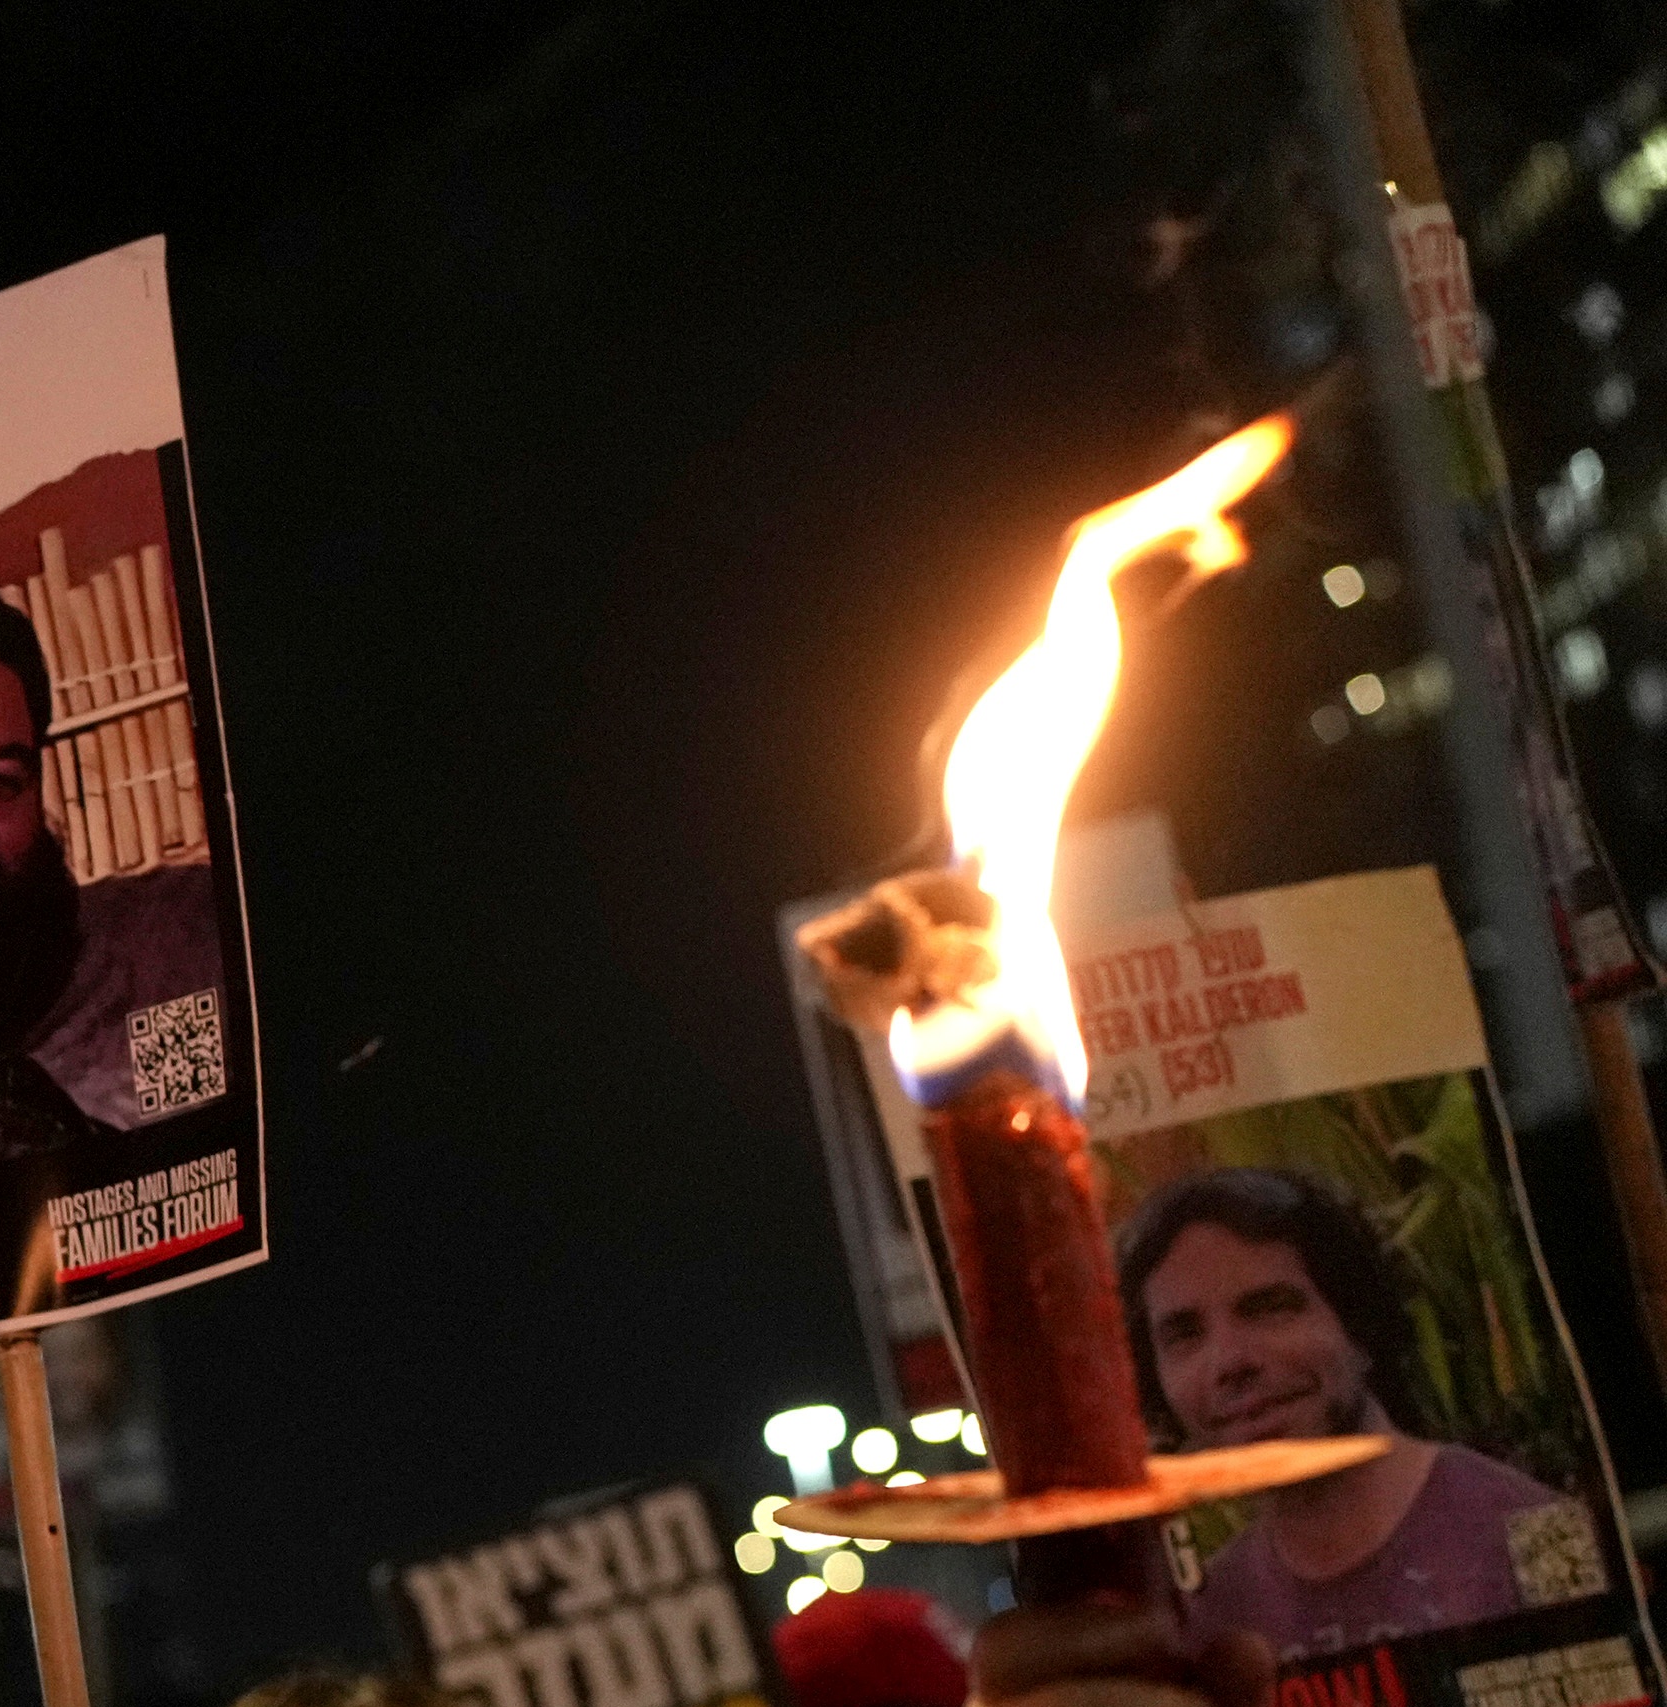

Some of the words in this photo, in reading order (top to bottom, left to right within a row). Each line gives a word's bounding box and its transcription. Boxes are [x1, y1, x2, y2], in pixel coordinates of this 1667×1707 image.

[1141, 969, 1308, 1045] KALDERON
[48, 1180, 135, 1228] HOSTAGES
[137, 1169, 168, 1207] AND
[169, 1148, 237, 1196] MISSING
[55, 1205, 159, 1271] FAMILIES
[162, 1178, 239, 1243] FORUM
